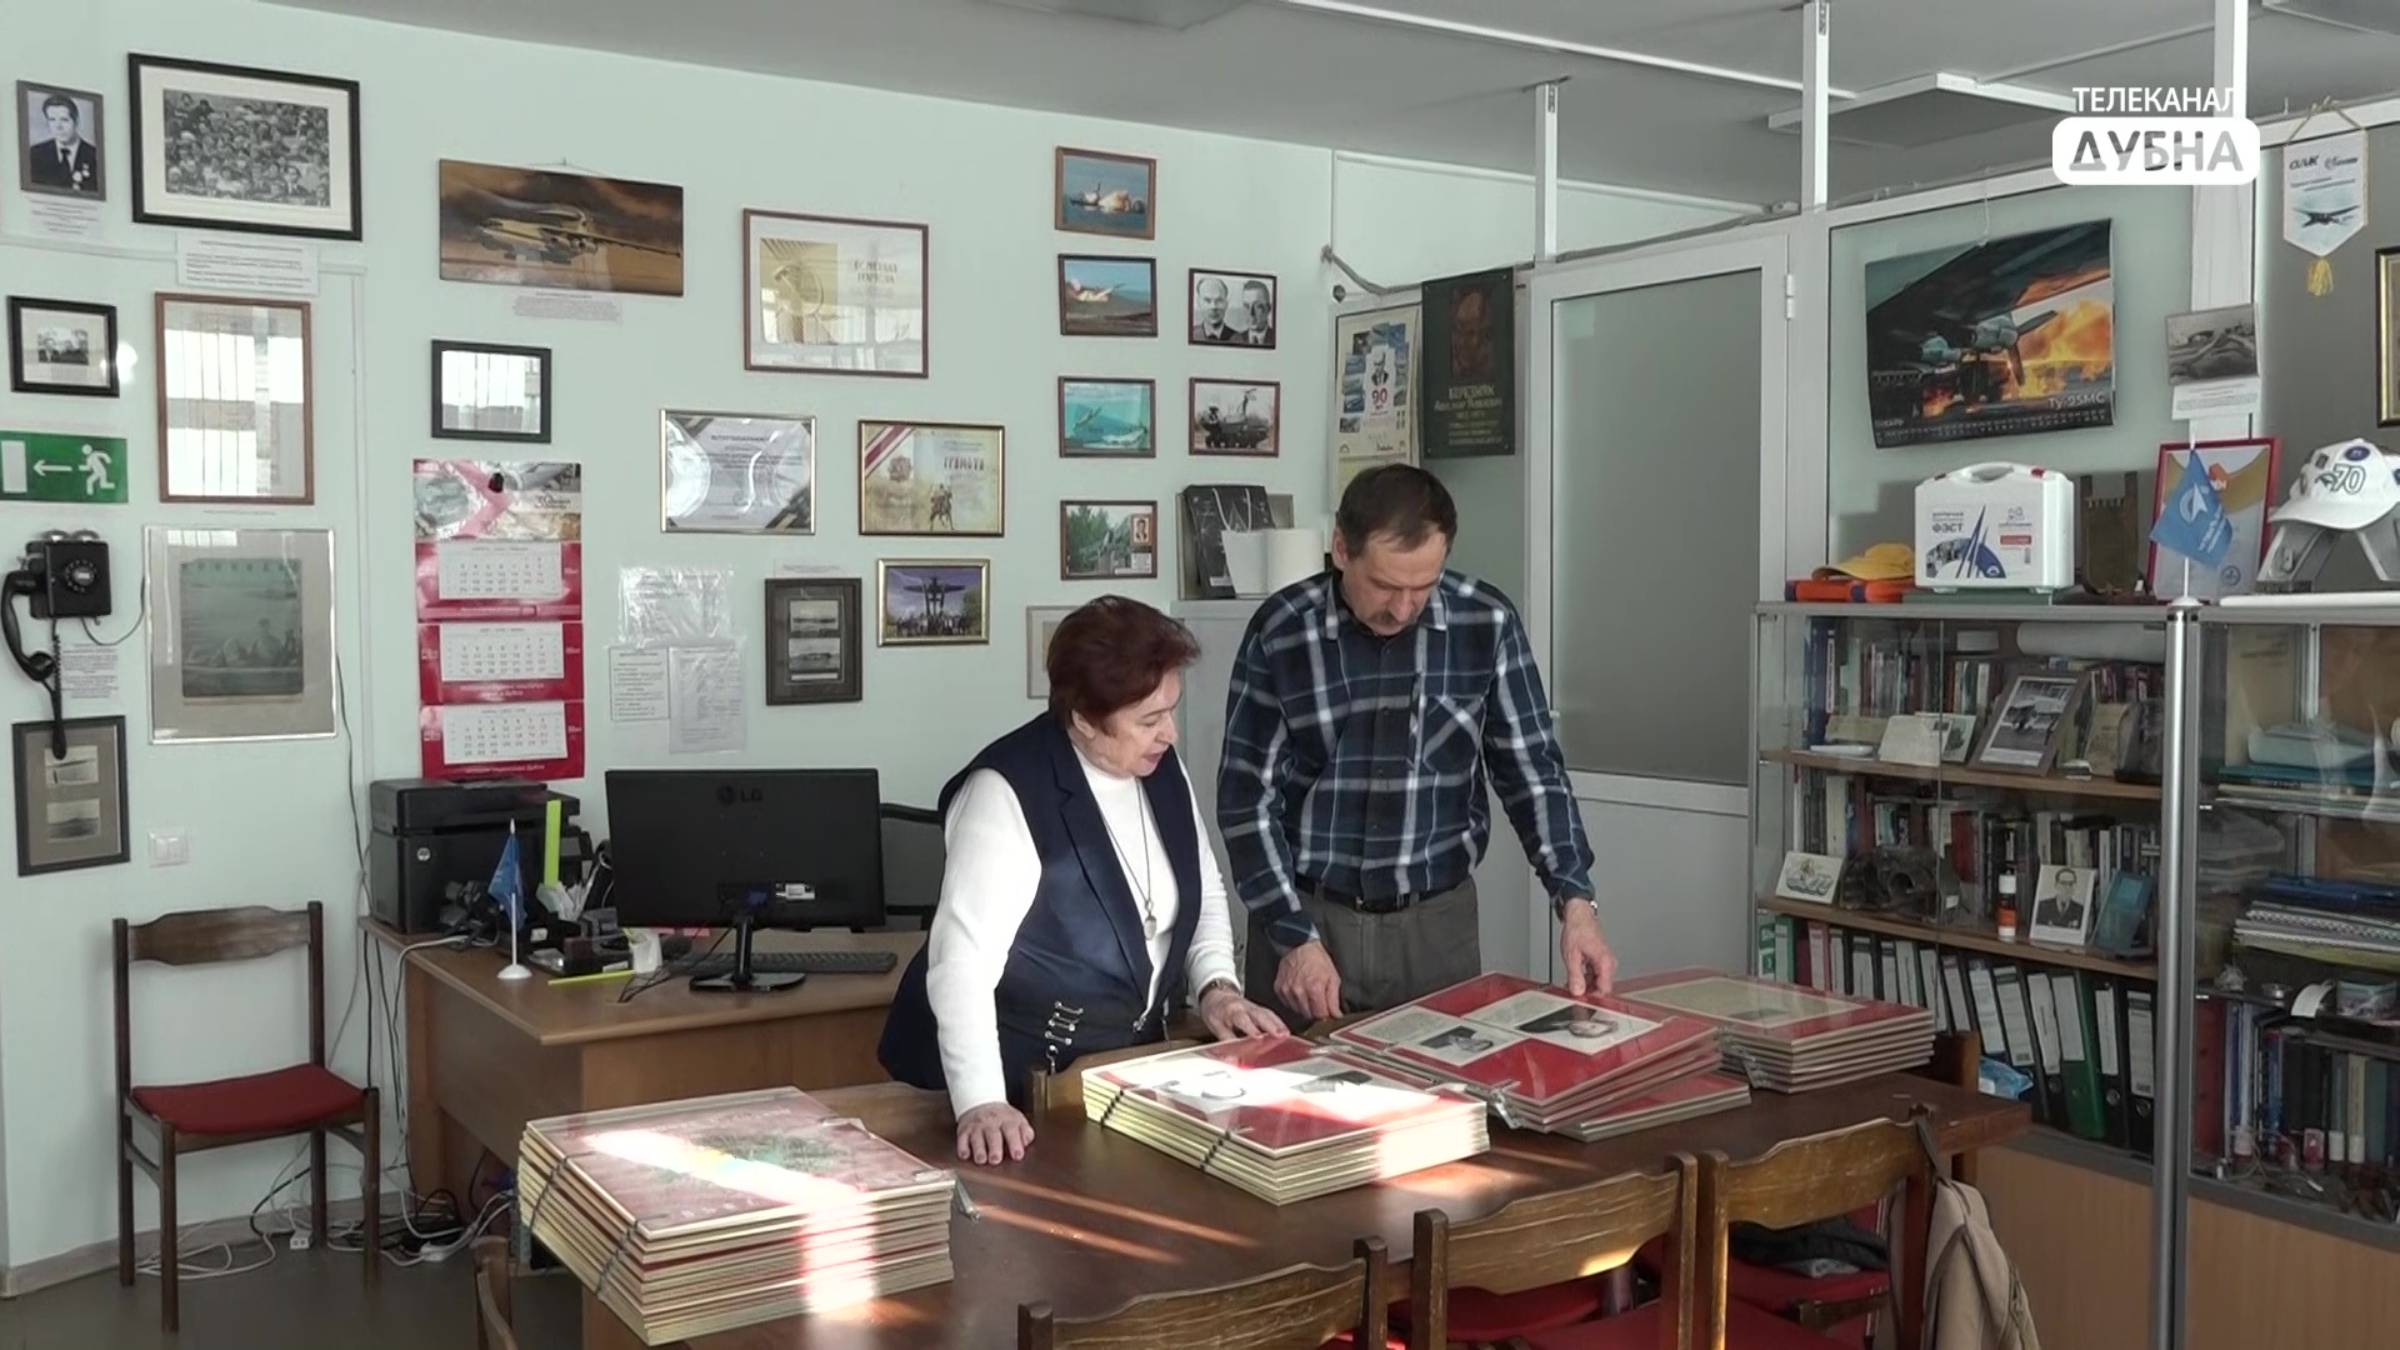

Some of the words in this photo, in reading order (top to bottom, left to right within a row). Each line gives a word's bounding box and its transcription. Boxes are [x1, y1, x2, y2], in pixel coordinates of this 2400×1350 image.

[1372, 387, 1387, 404] 90
[2330, 463, 2367, 495] 70
[741, 787, 763, 803] LG
